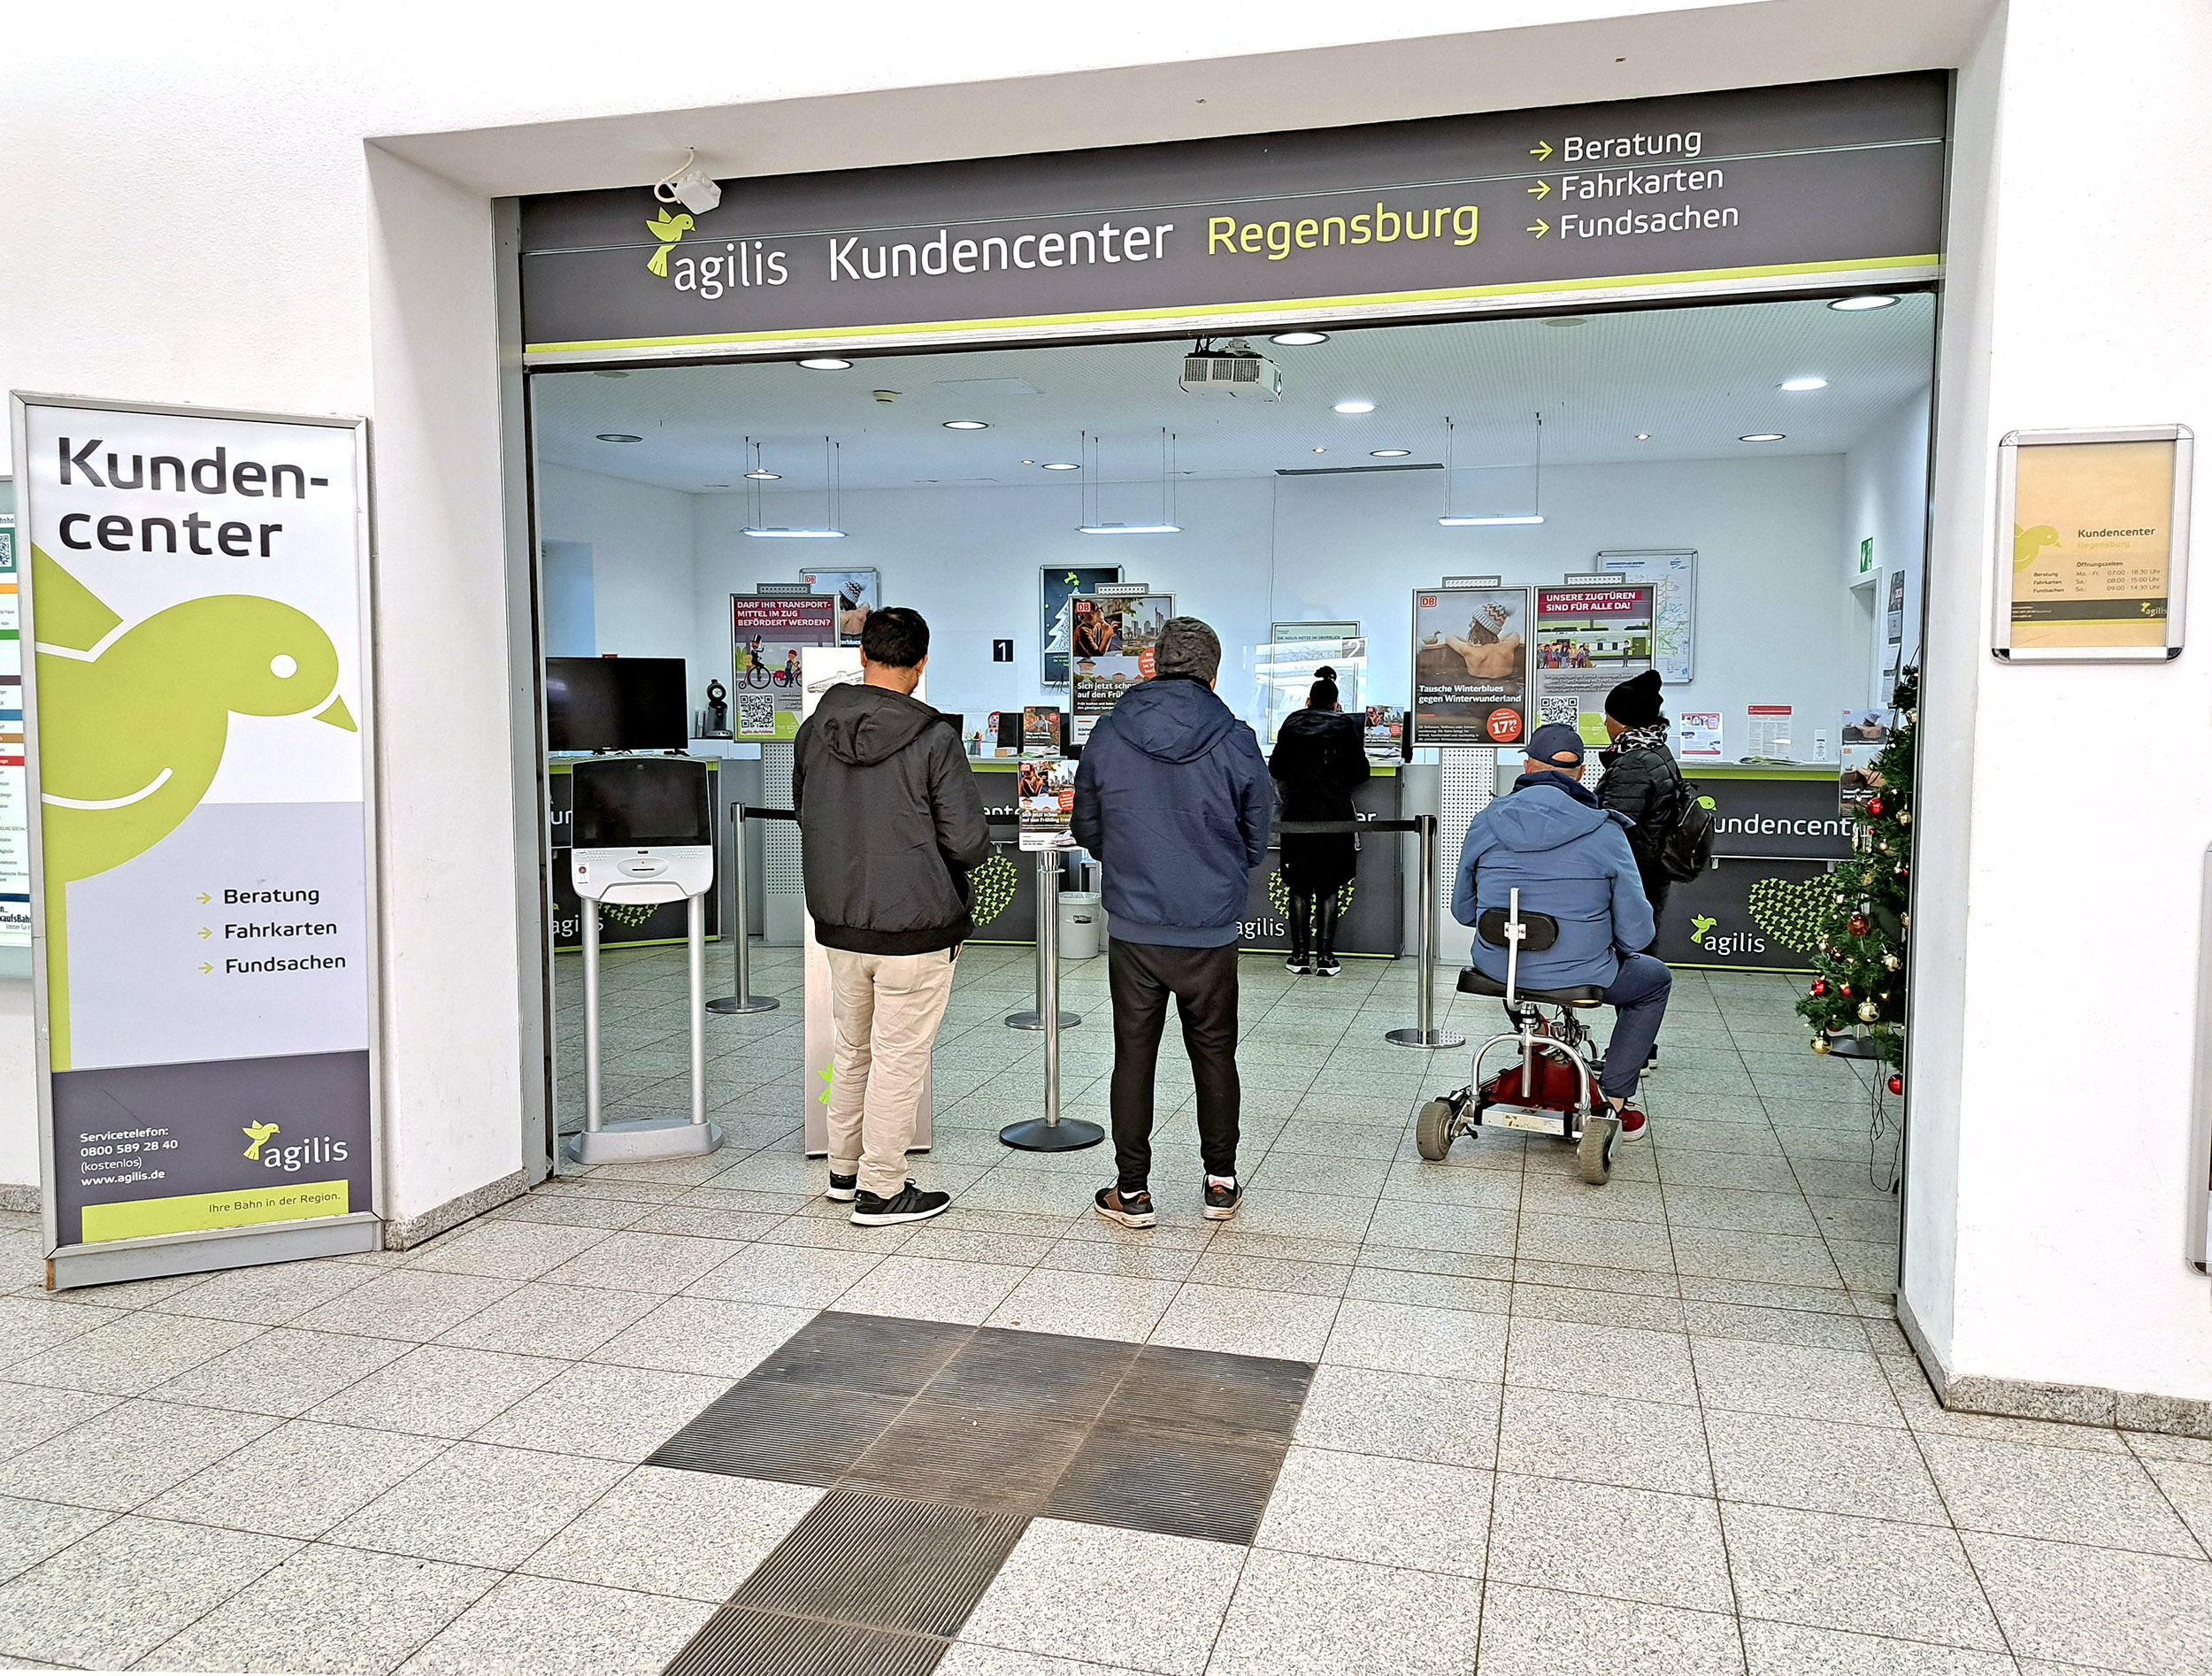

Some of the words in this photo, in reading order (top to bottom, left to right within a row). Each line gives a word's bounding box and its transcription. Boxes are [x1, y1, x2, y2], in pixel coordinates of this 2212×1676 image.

[1563, 127, 1703, 164] Beratung
[1560, 167, 1724, 202] Fahrkarten
[1559, 204, 1740, 240] Fundsachen
[673, 241, 788, 300] agilis
[829, 221, 1174, 282] Kundencenter
[1208, 202, 1480, 262] Regensburg
[58, 436, 328, 499] Kunden-
[59, 511, 283, 557] center
[2078, 527, 2156, 538] Kundencenter
[2077, 541, 2130, 550] Regensburg
[1421, 596, 1436, 607] DB
[1546, 593, 1583, 602] UNSERE
[1585, 591, 1635, 601] ZUGTÜREN
[1546, 603, 1569, 611] SIND
[1570, 602, 1589, 611] FÜR
[2145, 605, 2167, 617] agilis
[738, 618, 787, 627] BEFÖRDERT
[998, 642, 1006, 662] 1
[1347, 640, 1360, 657] 2
[1094, 681, 1113, 690] jetzt
[1714, 812, 1857, 837] undencent
[223, 888, 320, 906] Beratung
[224, 921, 338, 940] Fahrkarten
[553, 914, 603, 937] agis
[1236, 918, 1285, 940] agilis
[1704, 932, 1765, 956] agilis
[225, 954, 347, 974] Fundsachen
[81, 1127, 169, 1143] Servicetelefon:
[81, 1146, 115, 1157] 0800
[116, 1143, 140, 1155] 589
[142, 1142, 159, 1152] 28
[162, 1139, 179, 1150] 40
[264, 1135, 349, 1172] agilis
[81, 1156, 142, 1174] (kostenlos)
[81, 1169, 165, 1187] www.agilis.de
[209, 1203, 231, 1213] Ihre
[234, 1200, 263, 1211] Bahn
[266, 1198, 276, 1208] in
[279, 1196, 297, 1206] der
[300, 1192, 341, 1205] Region.
